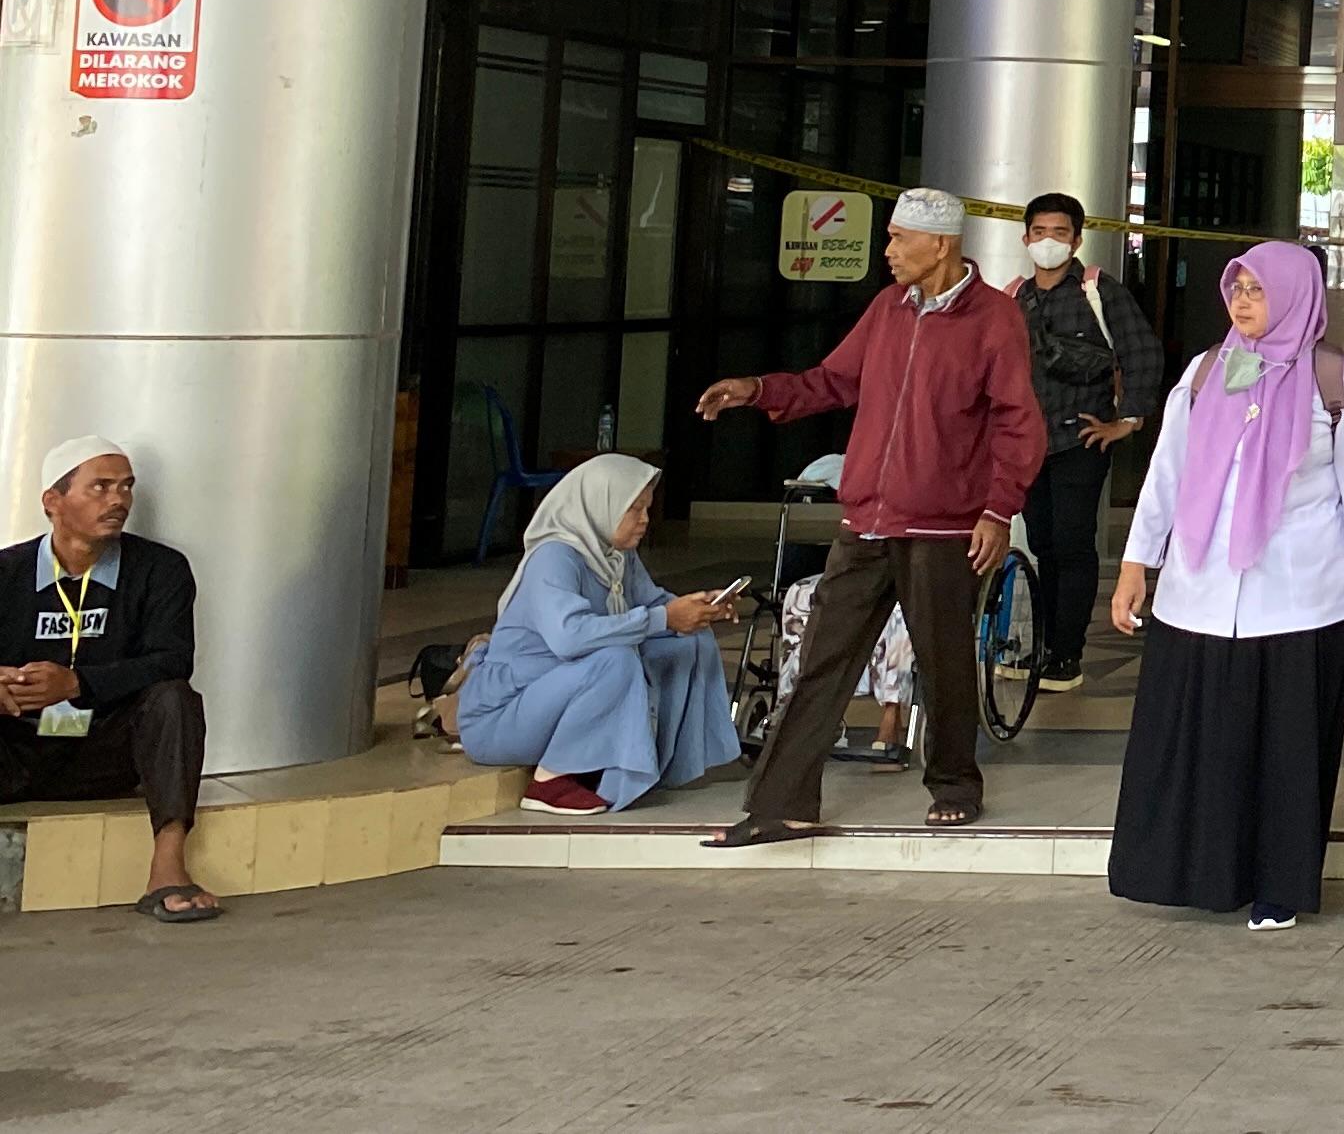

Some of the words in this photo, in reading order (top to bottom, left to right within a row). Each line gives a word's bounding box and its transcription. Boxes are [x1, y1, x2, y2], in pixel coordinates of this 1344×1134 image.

[86, 32, 181, 47] KAWASAN
[80, 53, 186, 70] DILARANG
[79, 72, 183, 89] MEROKOK
[821, 239, 864, 252] BEBAS
[820, 256, 864, 268] ROKOK
